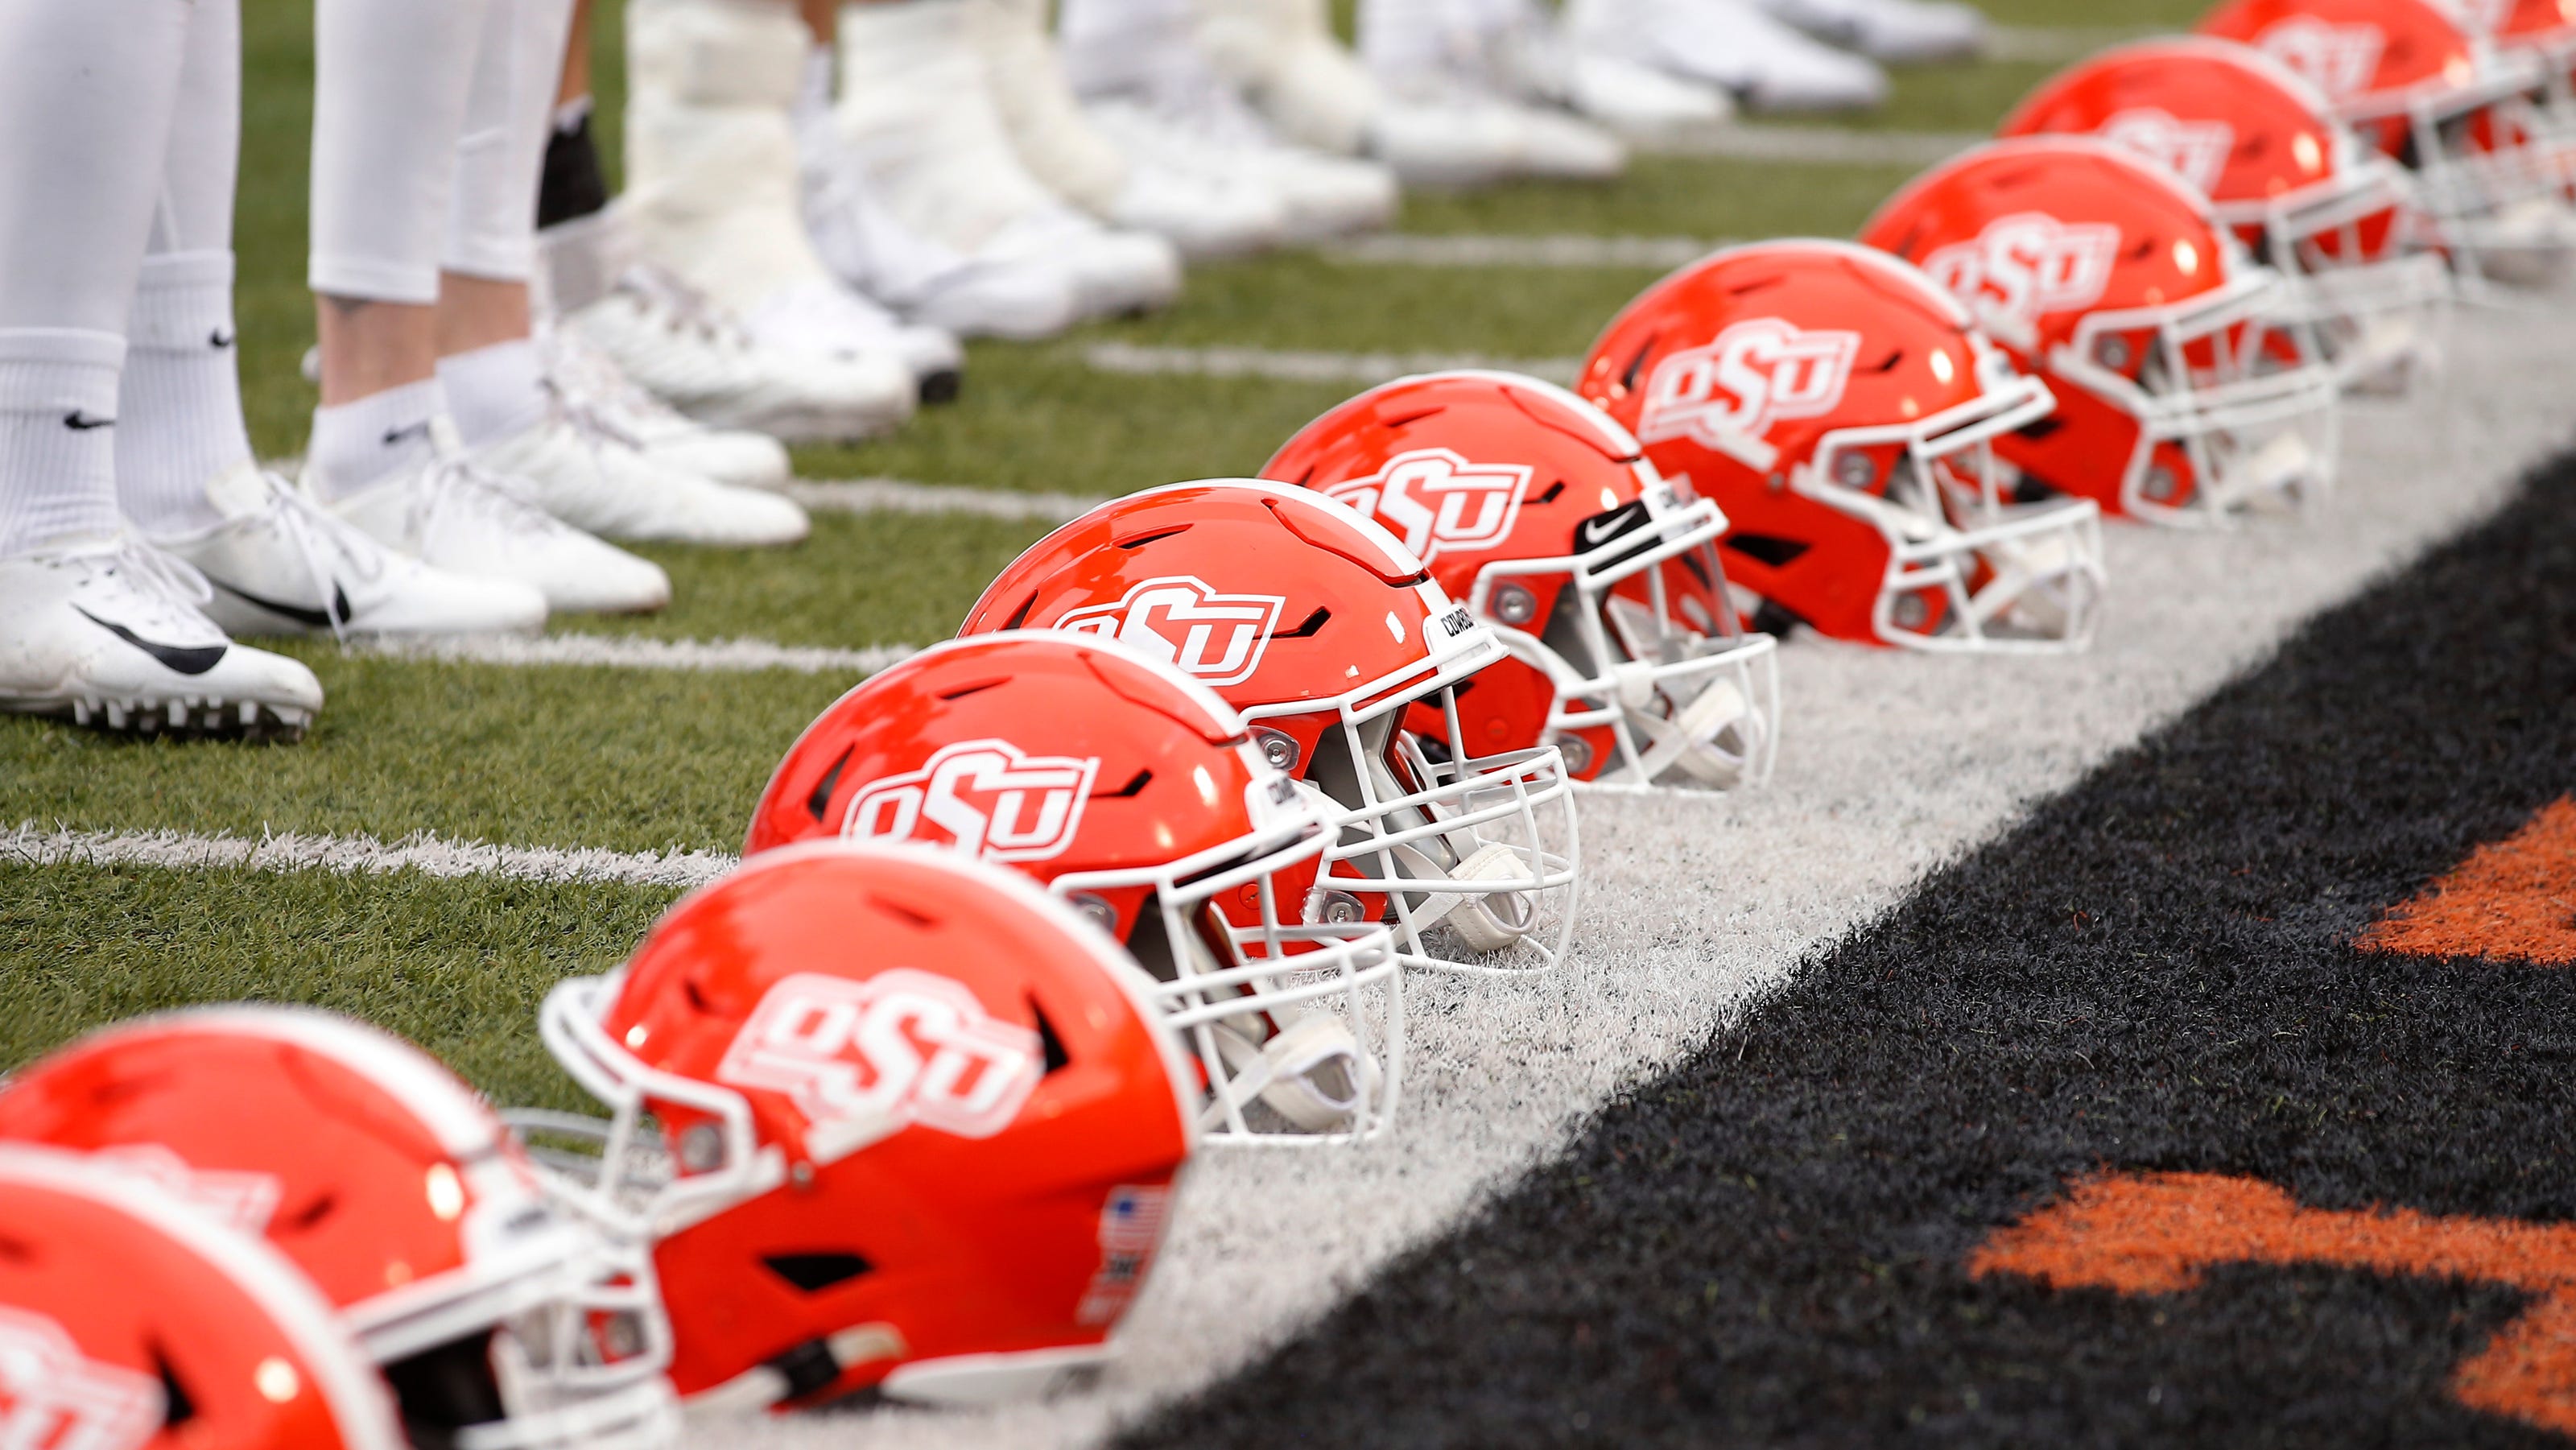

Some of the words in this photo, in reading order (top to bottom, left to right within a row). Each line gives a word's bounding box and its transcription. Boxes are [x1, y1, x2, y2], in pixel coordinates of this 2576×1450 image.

[1642, 319, 1858, 443] OSU
[844, 742, 1095, 860] OSU
[721, 971, 1040, 1137] OSU
